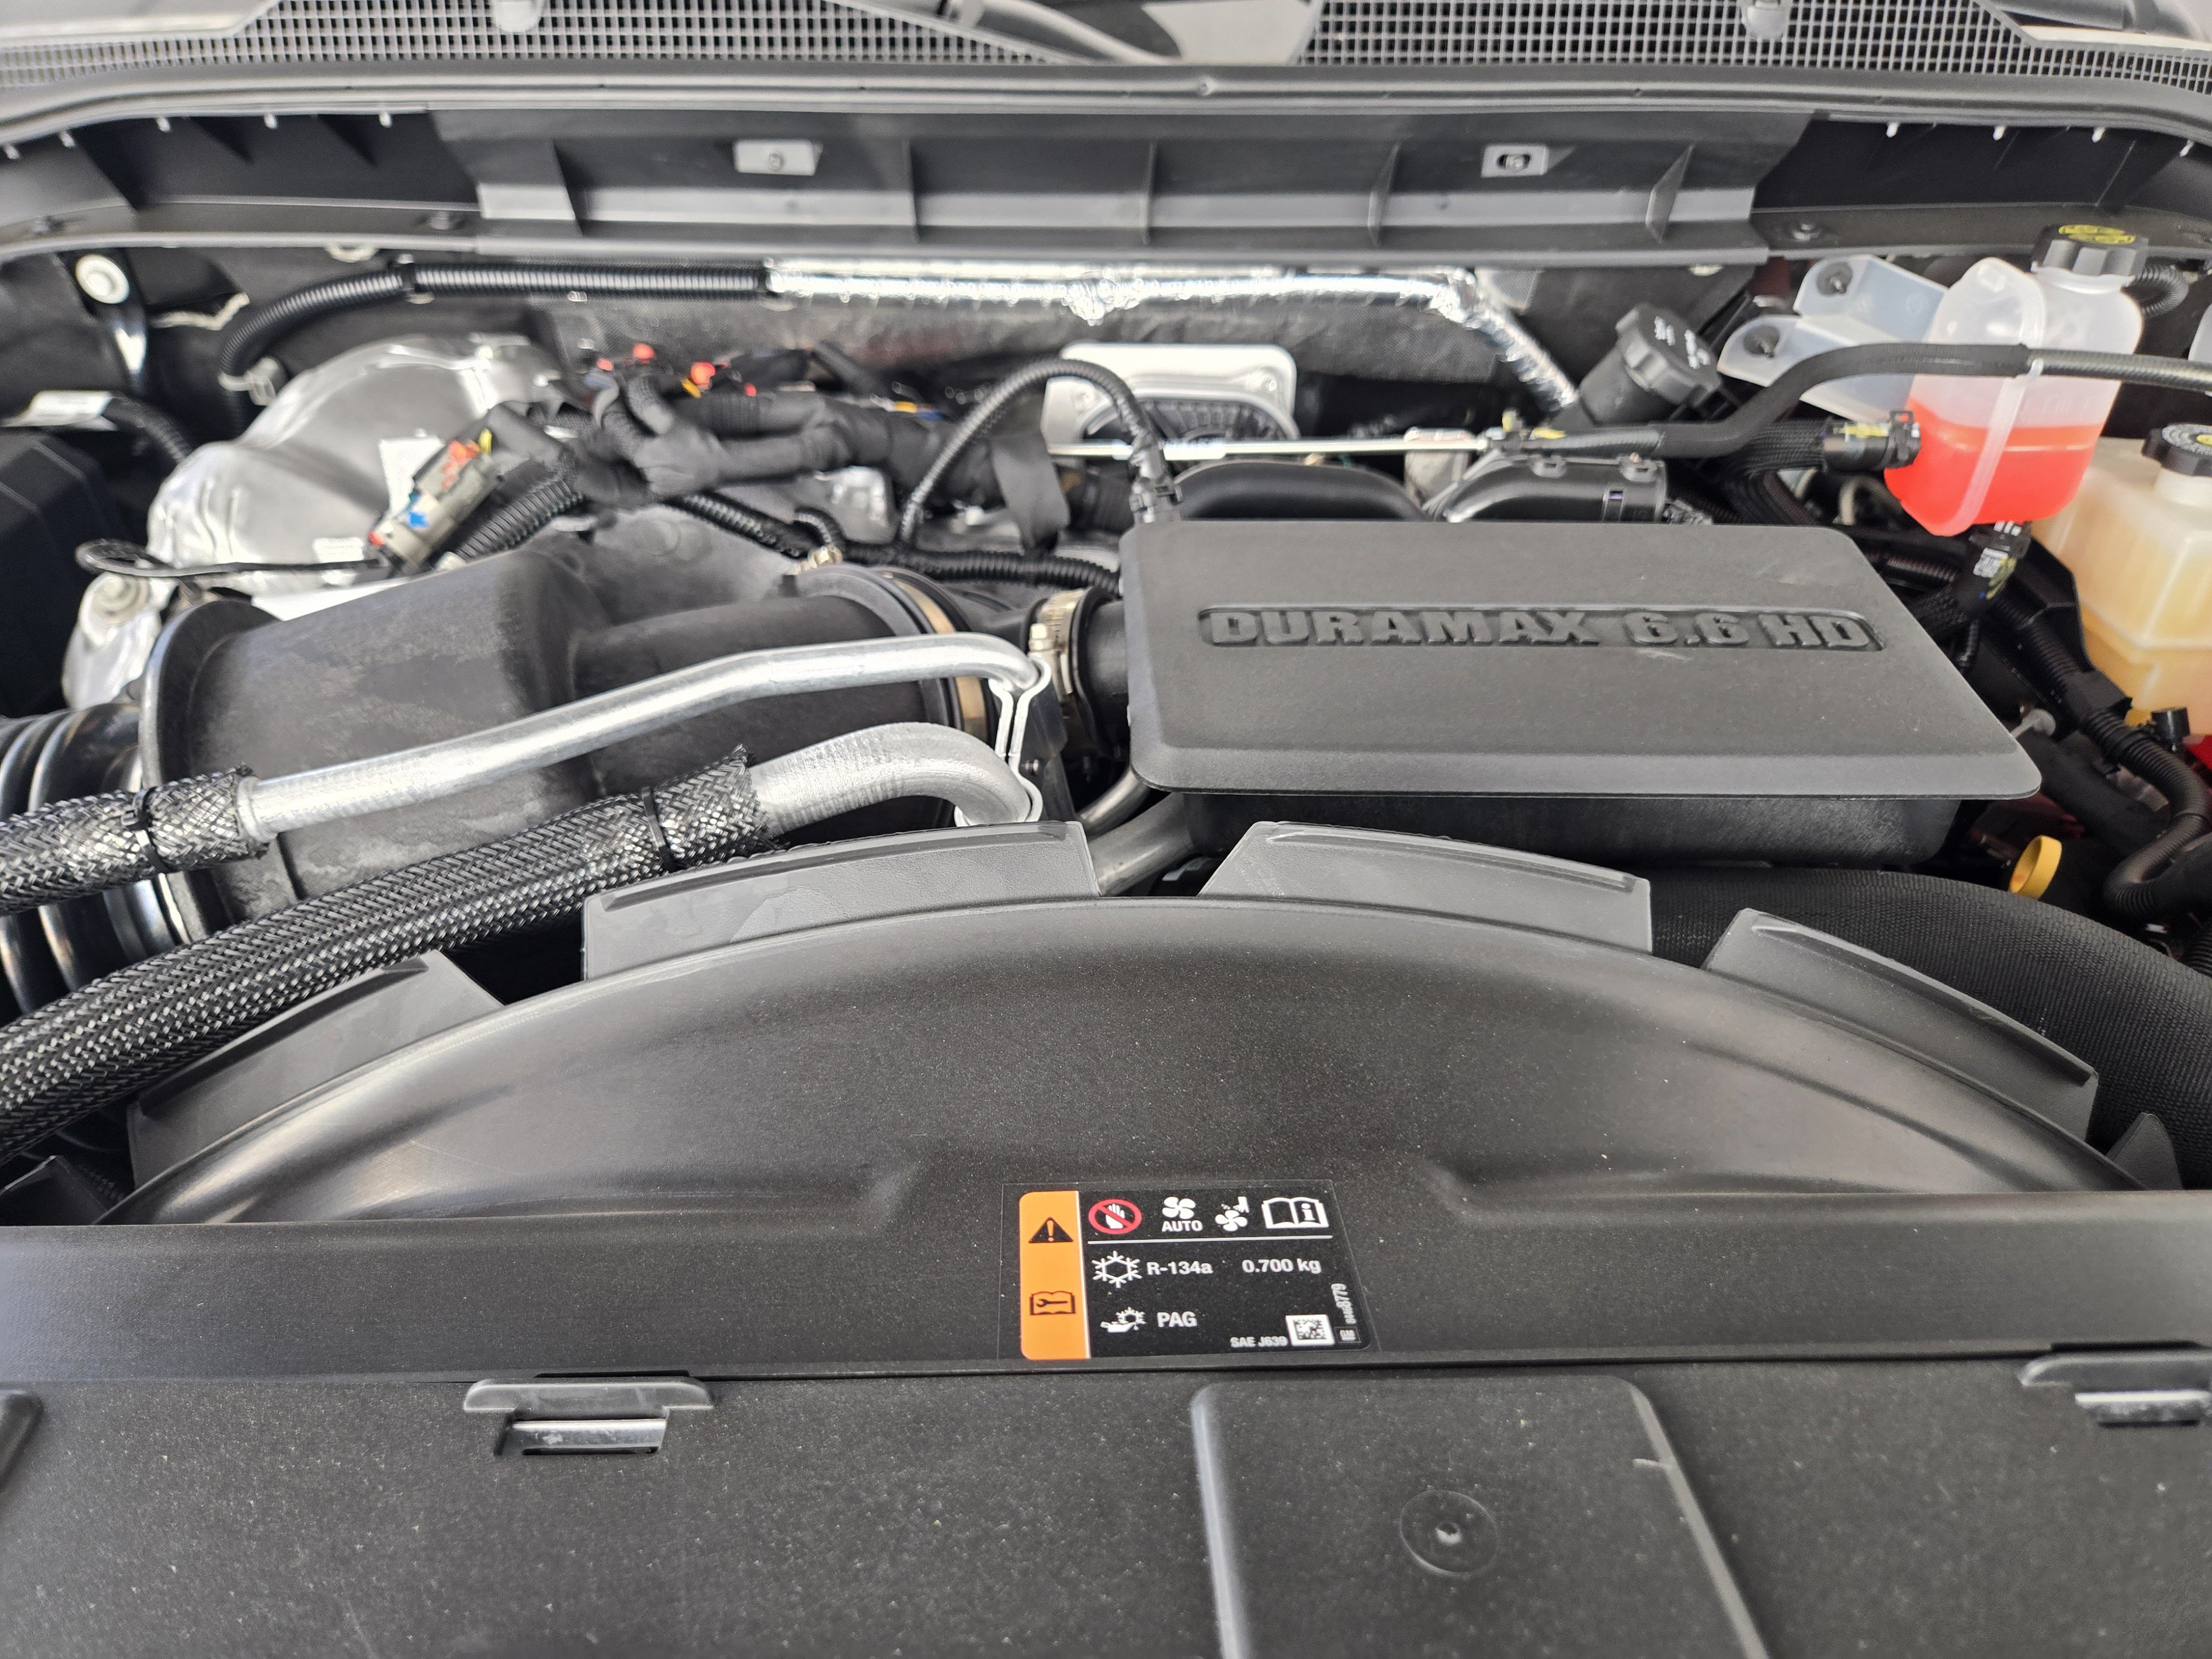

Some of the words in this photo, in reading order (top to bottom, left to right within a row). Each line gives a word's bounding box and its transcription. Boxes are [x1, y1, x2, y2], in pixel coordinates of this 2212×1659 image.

[1210, 611, 1600, 646] DURAMAX
[1624, 612, 1750, 646] 6.6
[1761, 614, 1872, 648] HD
[1162, 1220, 1203, 1232] AUTO
[1147, 1261, 1213, 1275] R-134a
[1241, 1259, 1293, 1273] 0.700
[1297, 1259, 1322, 1274] kg
[1157, 1312, 1198, 1327] PAG
[1230, 1337, 1256, 1348] SAE
[1258, 1335, 1288, 1348] J639
[1339, 1329, 1357, 1341] GM
